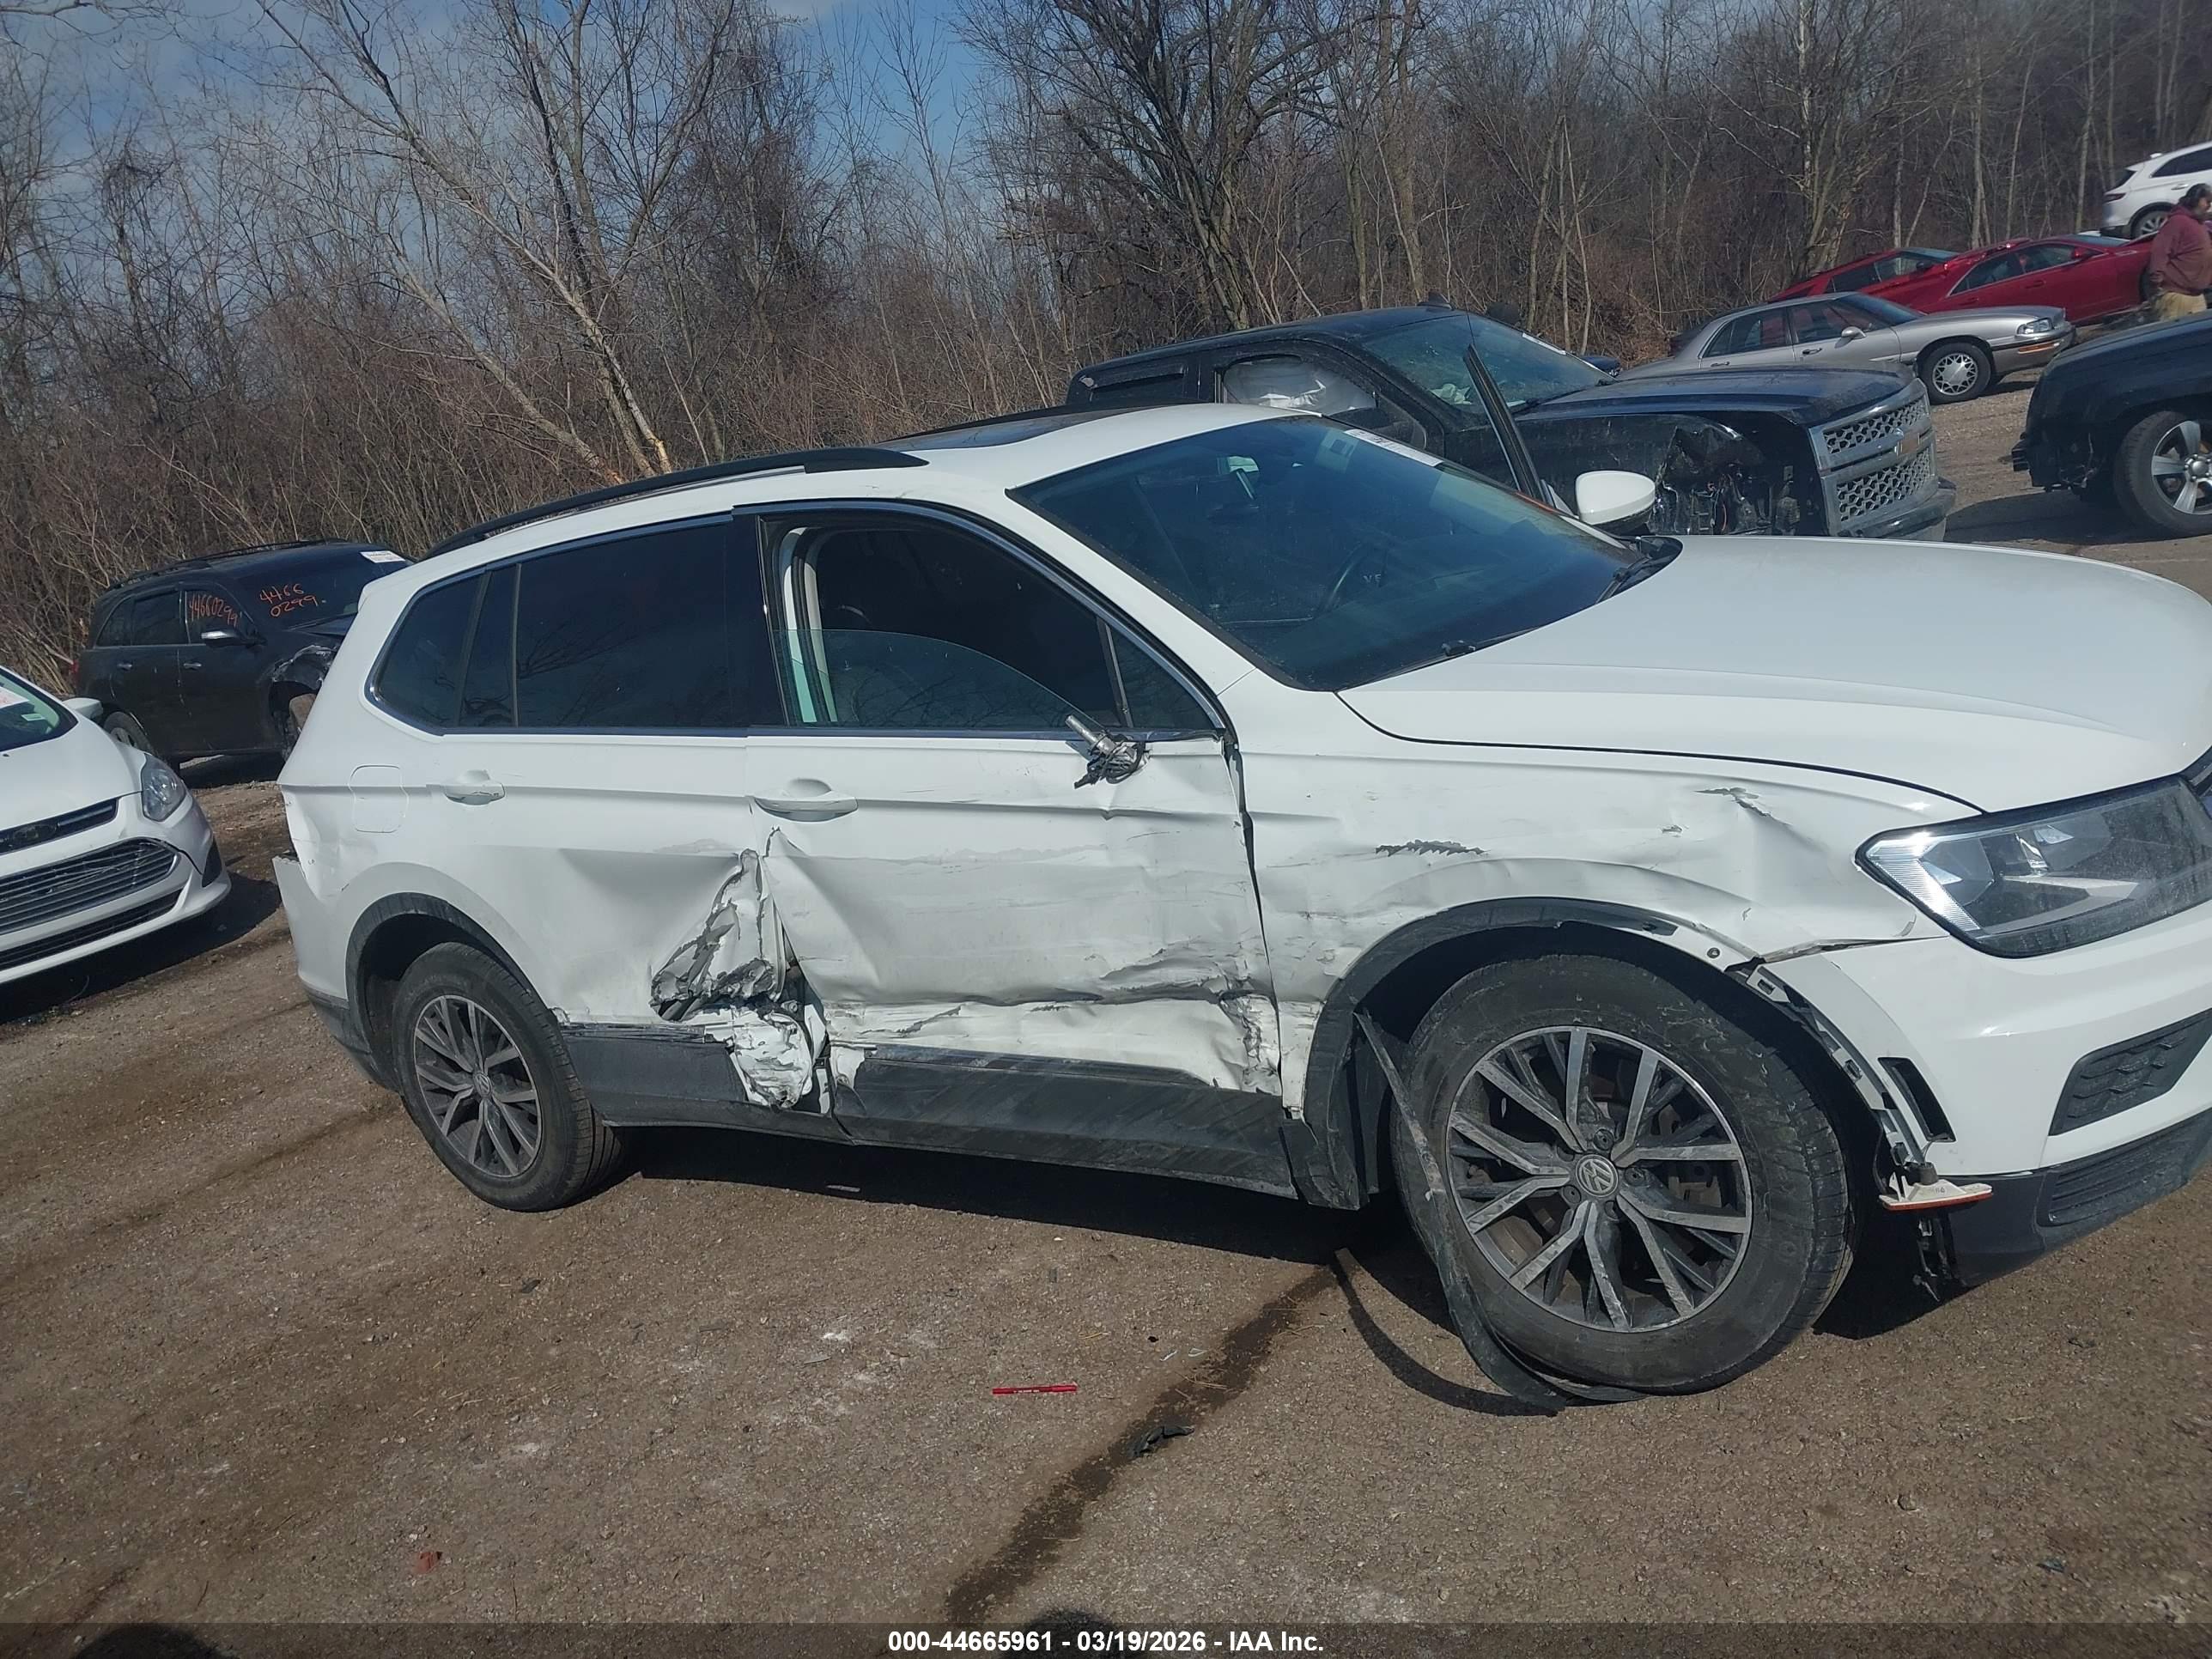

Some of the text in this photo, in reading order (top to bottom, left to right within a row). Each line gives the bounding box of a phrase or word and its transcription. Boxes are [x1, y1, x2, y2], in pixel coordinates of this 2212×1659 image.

[259, 583, 305, 604] 4466
[270, 594, 319, 617] 0299
[188, 592, 238, 628] 44660299
[1578, 1158, 1615, 1194] VW
